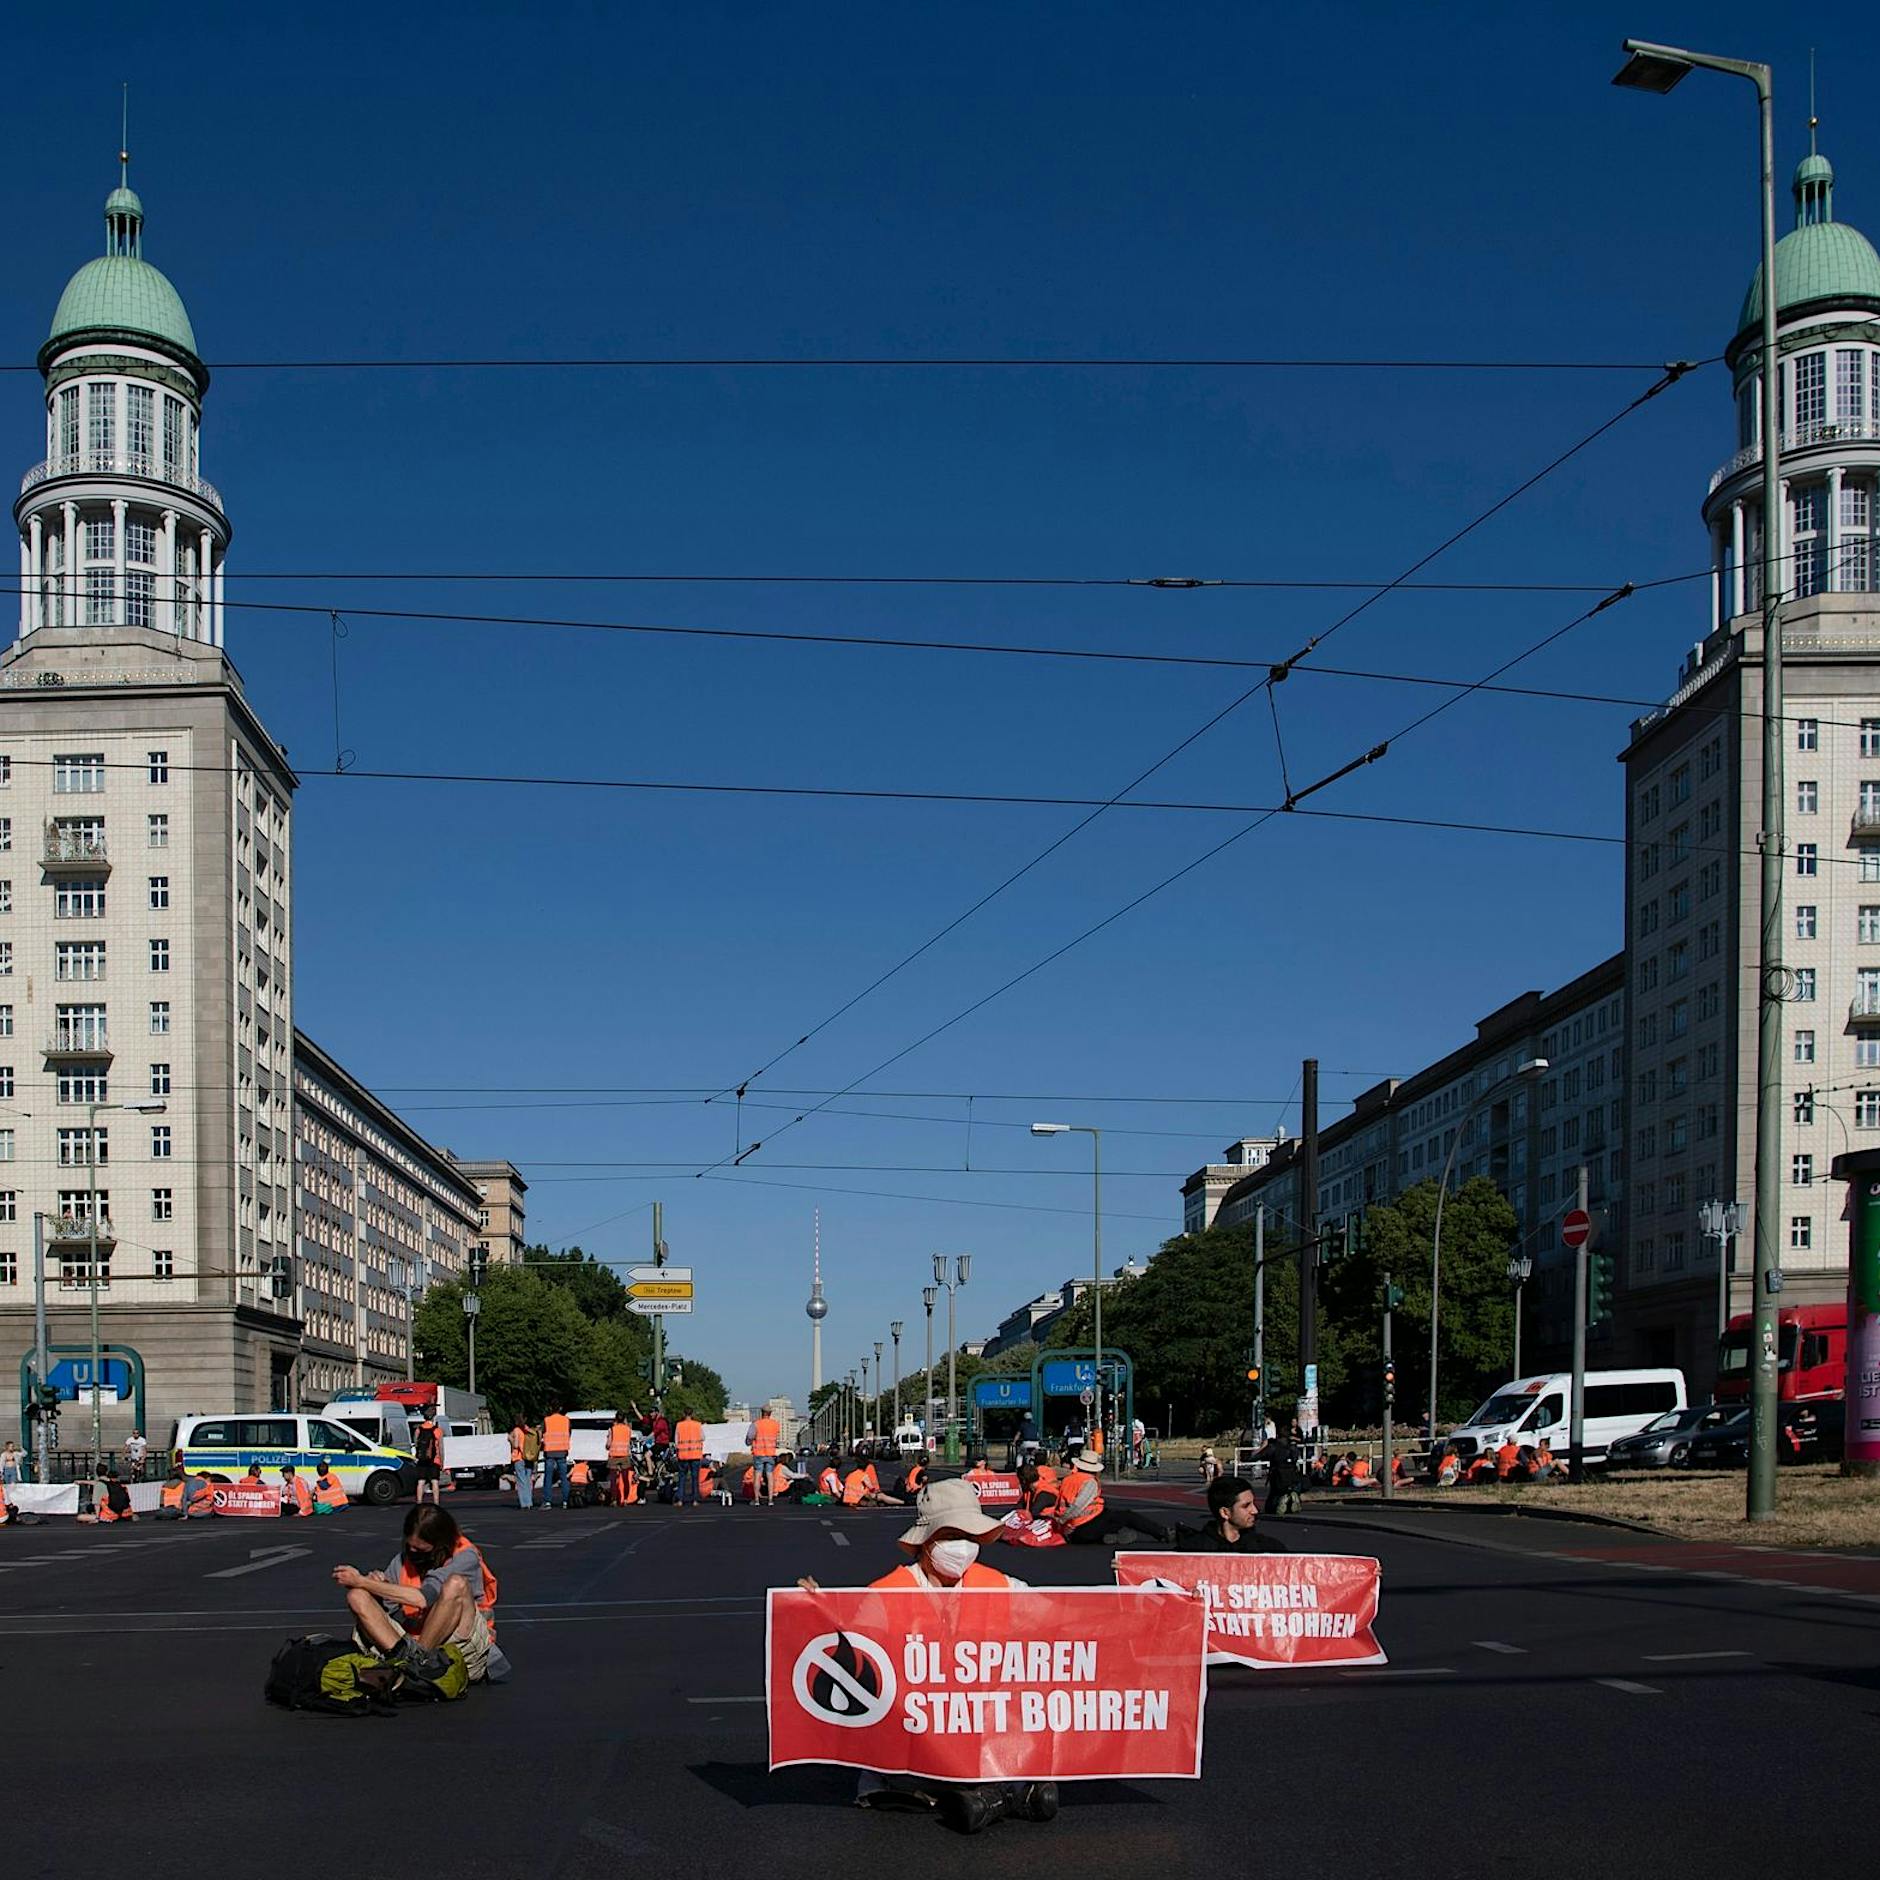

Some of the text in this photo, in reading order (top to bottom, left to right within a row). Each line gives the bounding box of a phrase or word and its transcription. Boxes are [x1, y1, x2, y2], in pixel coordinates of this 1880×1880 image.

[638, 1302, 688, 1311] Mercedes-Platz
[73, 1364, 89, 1383] U
[1000, 1384, 1011, 1397] U
[251, 1454, 291, 1464] POLIZEI
[1196, 1580, 1319, 1610] ÖL SPAREN
[1270, 1612, 1357, 1639] BOHREN
[903, 1634, 1097, 1685] ÖL SPAREN
[903, 1689, 1169, 1735] STATT BOHREN
